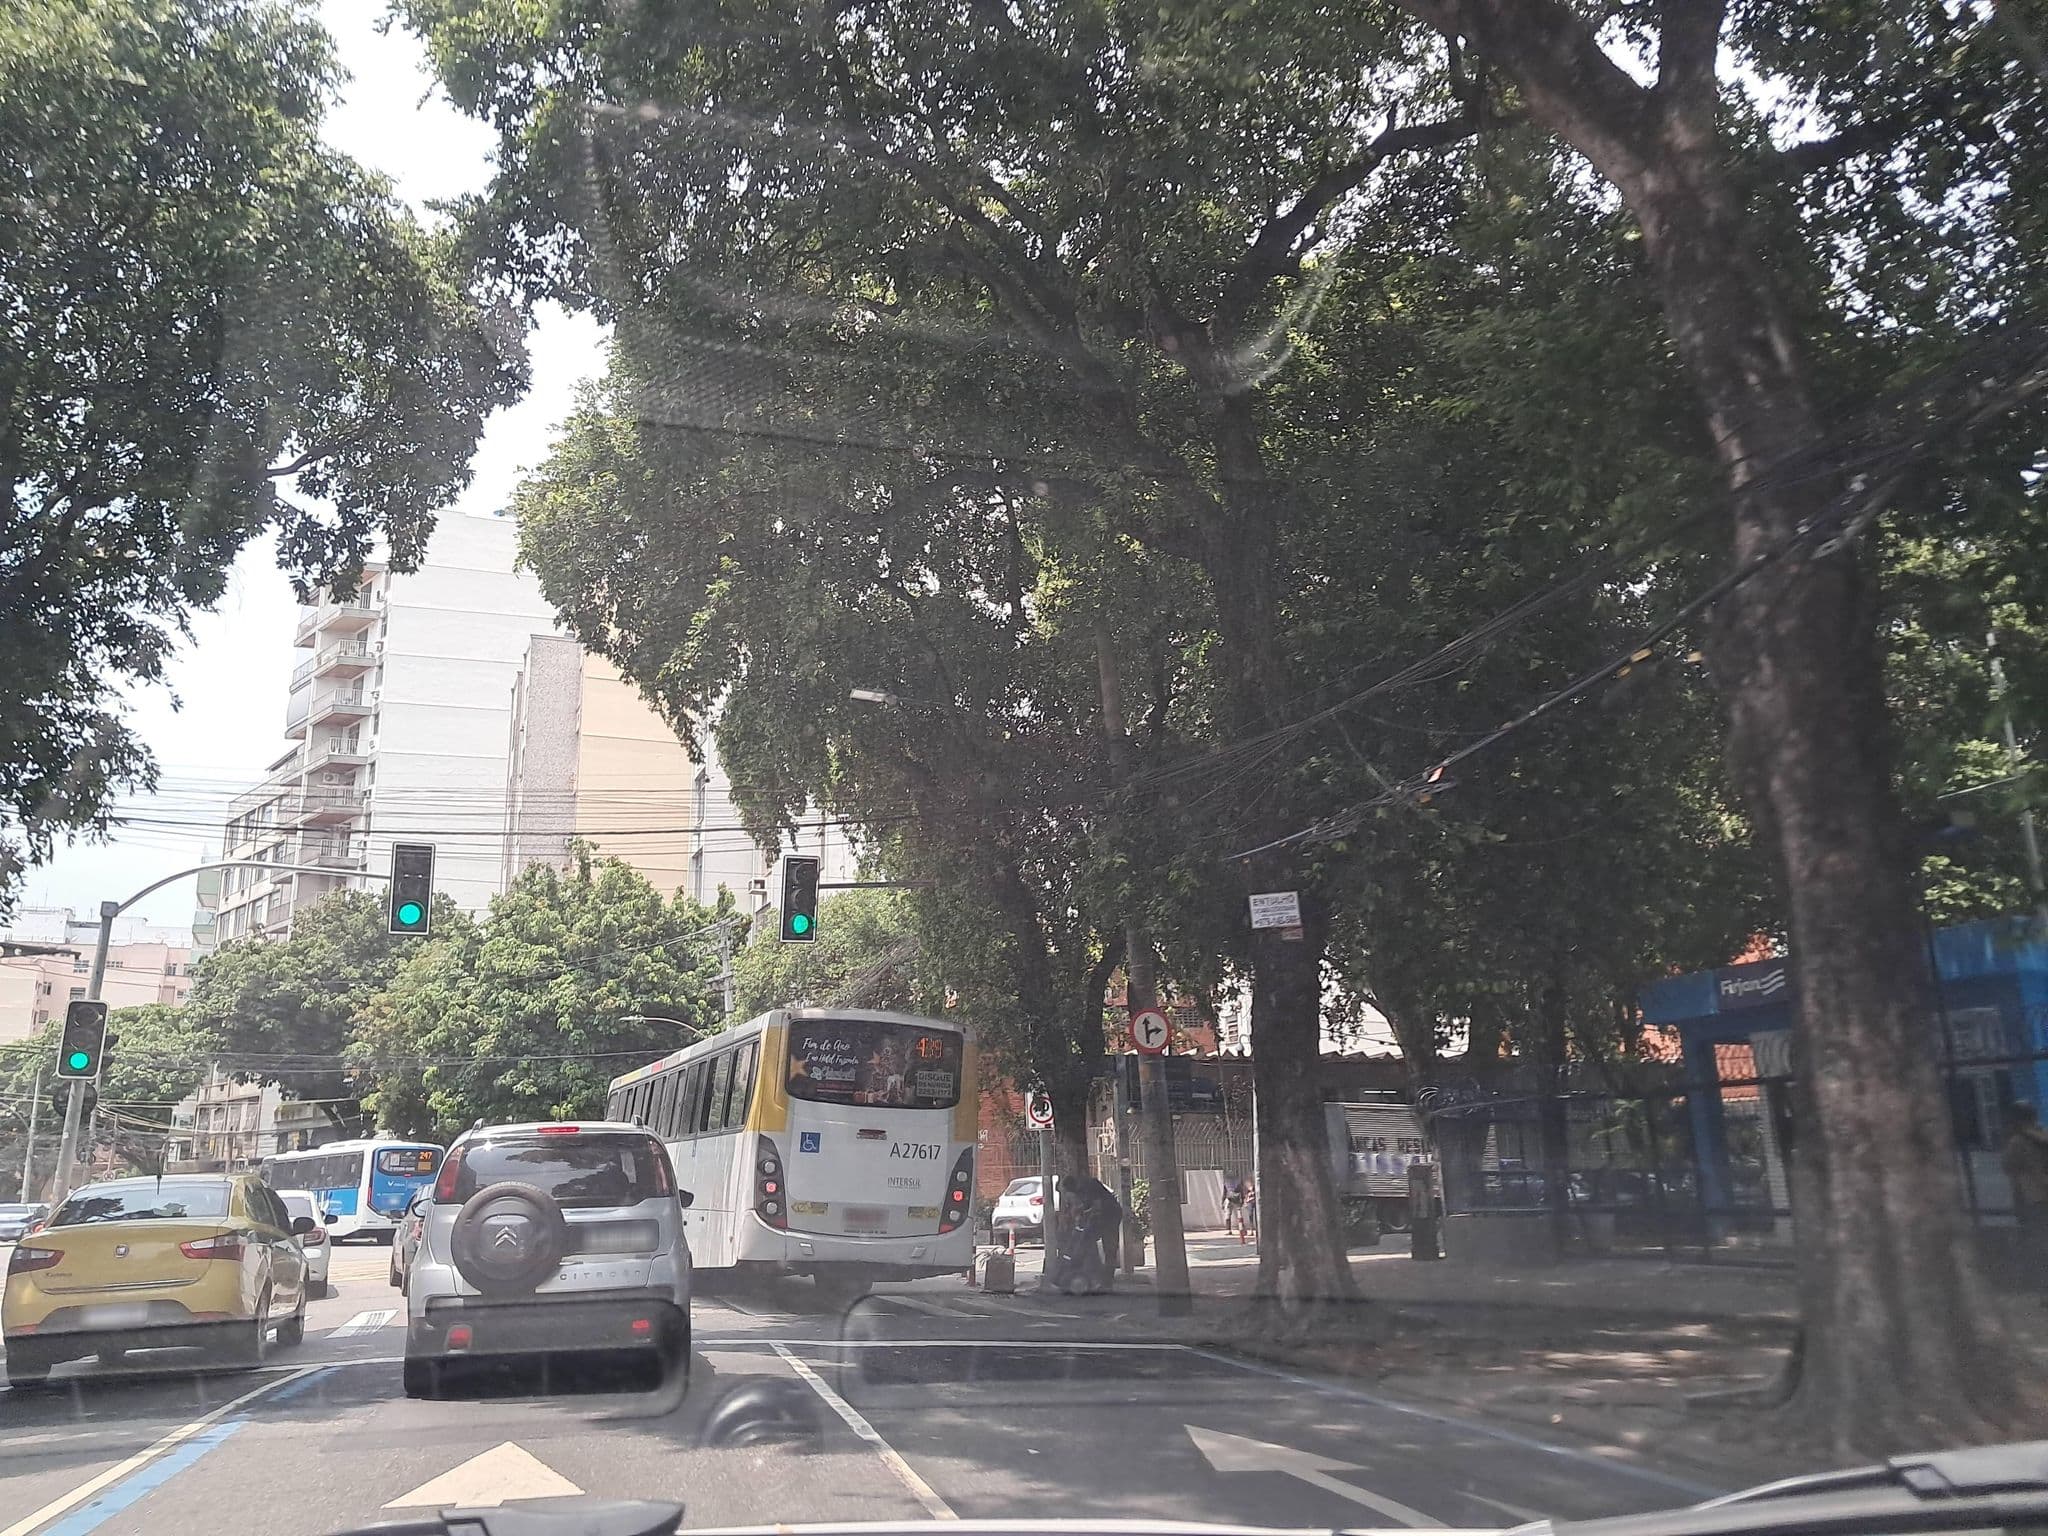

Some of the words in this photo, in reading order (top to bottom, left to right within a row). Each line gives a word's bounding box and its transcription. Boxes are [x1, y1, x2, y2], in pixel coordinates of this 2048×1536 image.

[1720, 978, 1761, 996] Firjan
[819, 1039, 832, 1051] de
[833, 1039, 850, 1051] Ano
[918, 1072, 952, 1082] DISQUE
[419, 1151, 432, 1160] 247
[889, 1142, 942, 1160] A27617
